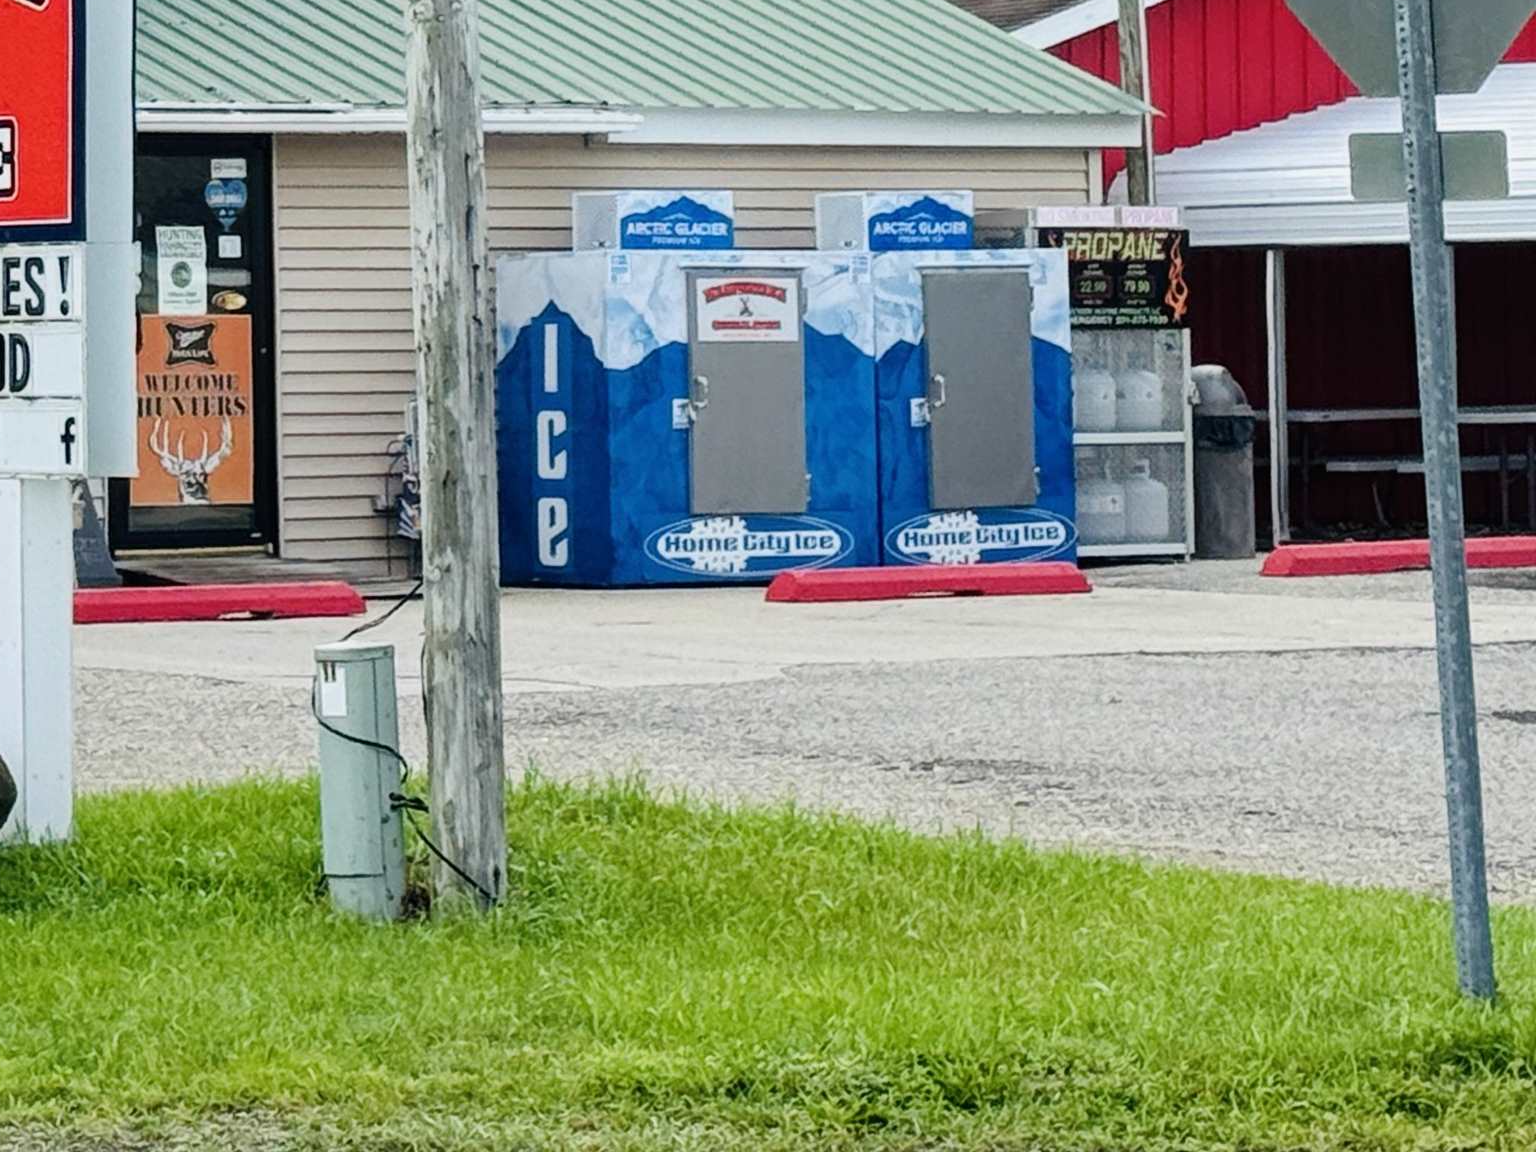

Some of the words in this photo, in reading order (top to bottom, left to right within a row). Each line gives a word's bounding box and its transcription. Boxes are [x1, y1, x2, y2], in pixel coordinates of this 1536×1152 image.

[625, 221, 673, 236] ARCTIC
[674, 222, 729, 237] GLACIER
[873, 221, 917, 236] ARCTIC
[918, 220, 968, 235] GLACIER
[1063, 231, 1170, 261] PROPANE
[144, 373, 240, 391] WELCOME
[664, 535, 739, 553] Home
[742, 533, 790, 554] City
[794, 533, 834, 550] Ice
[903, 530, 972, 548] Home
[975, 527, 1020, 546] City
[1023, 525, 1060, 542] Ice
